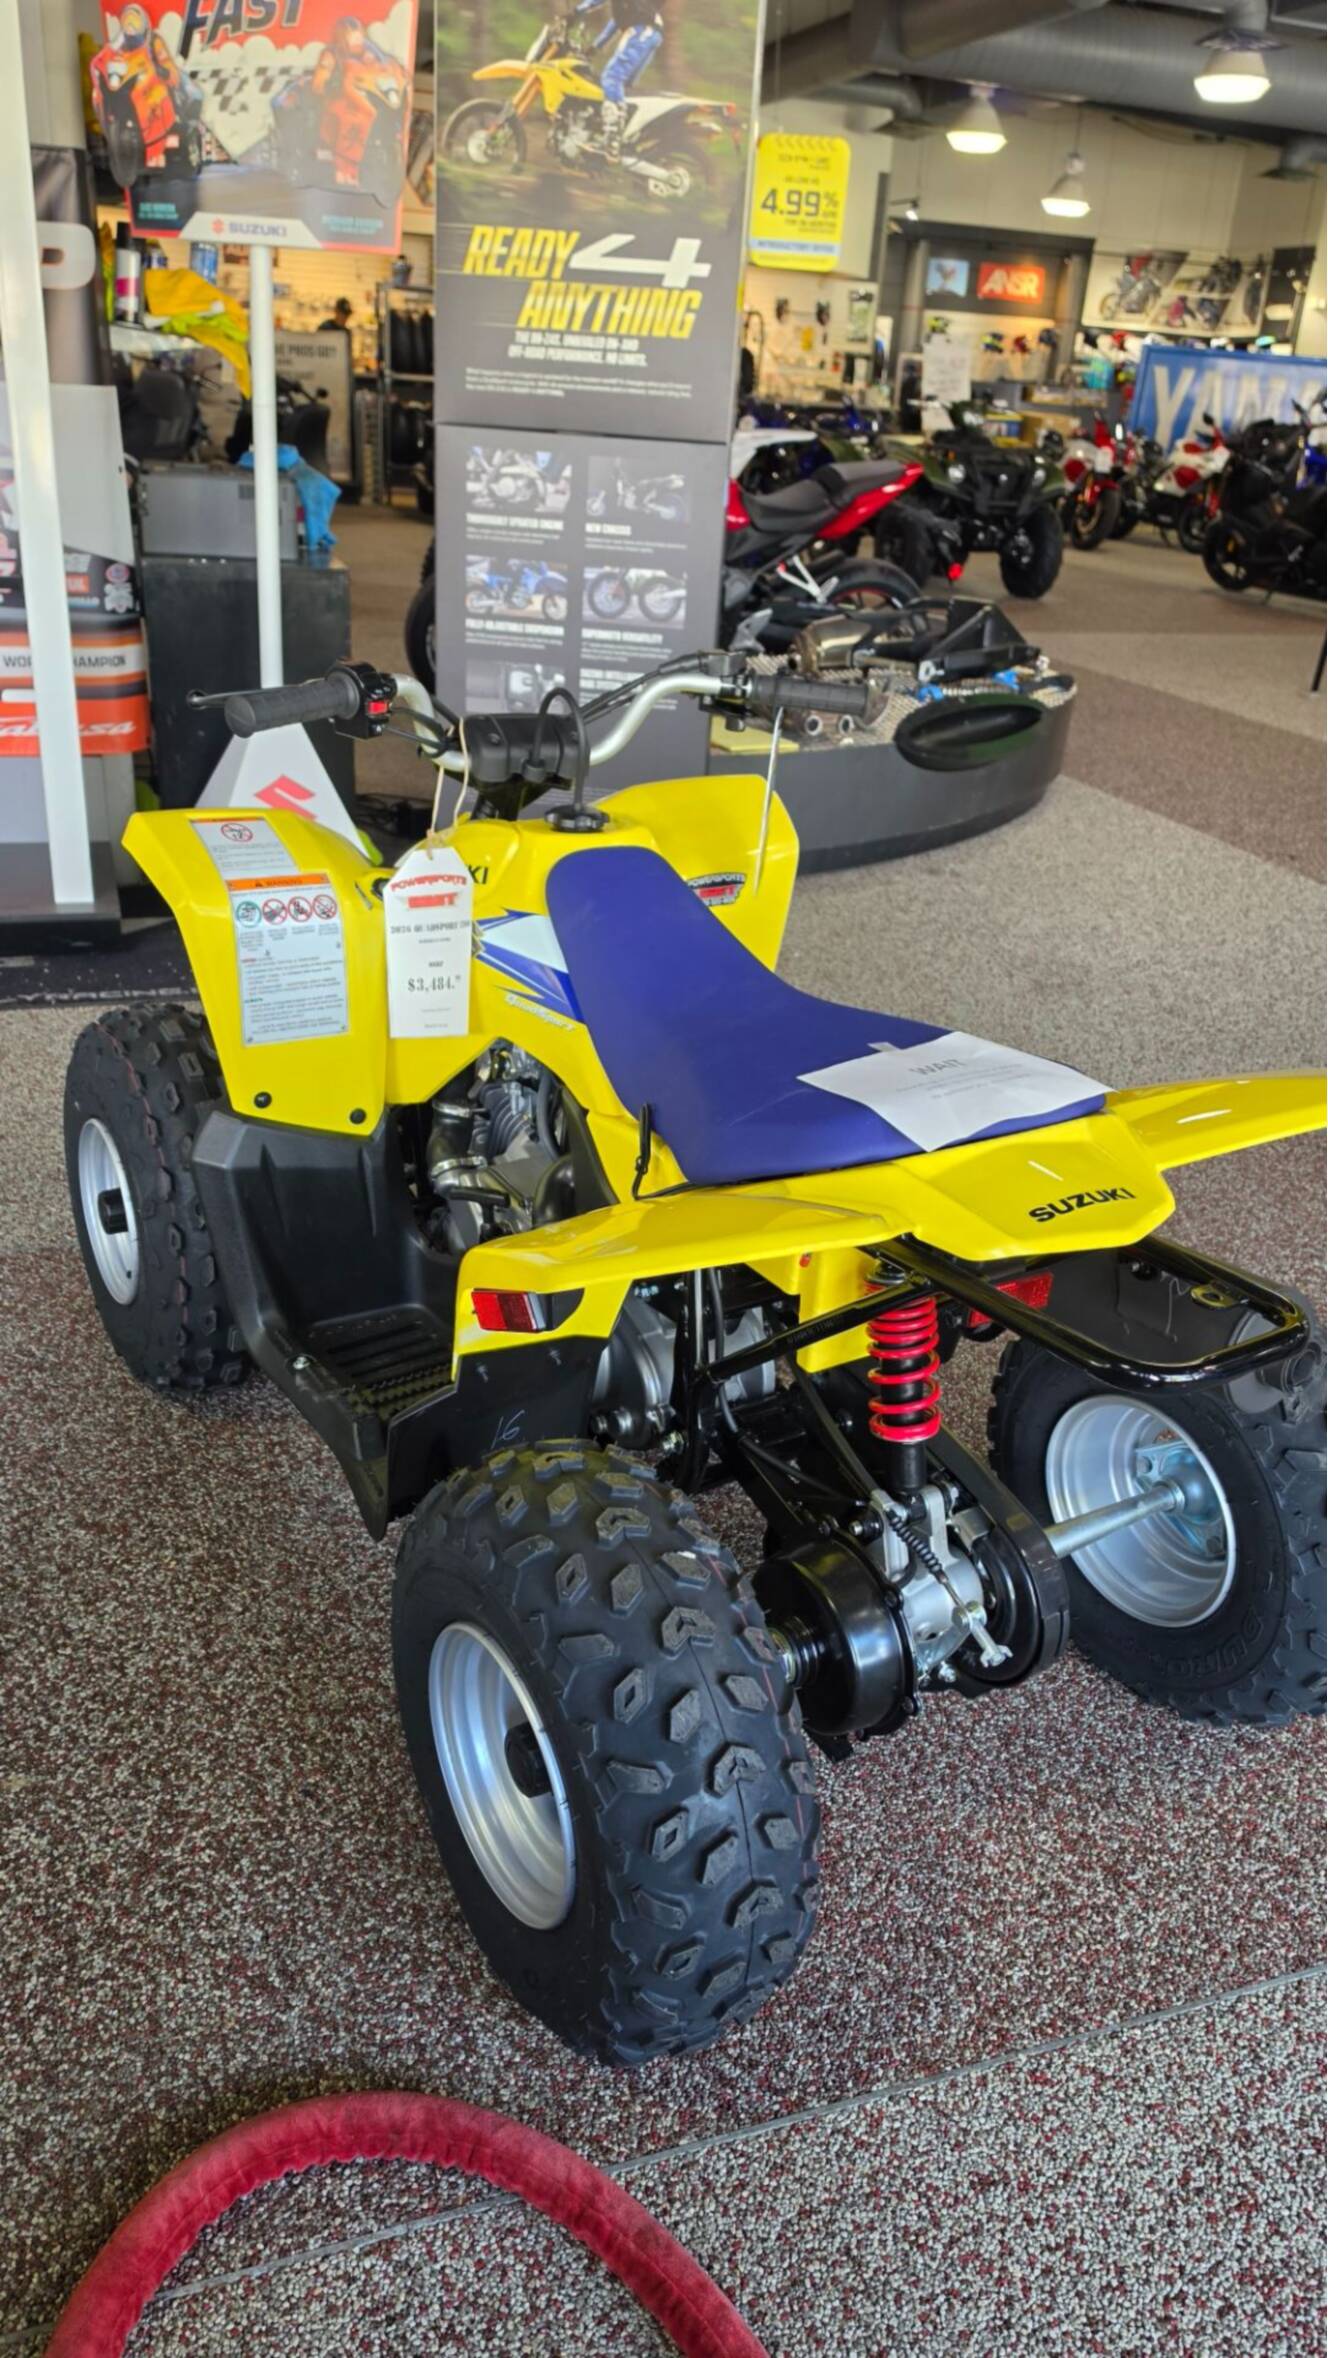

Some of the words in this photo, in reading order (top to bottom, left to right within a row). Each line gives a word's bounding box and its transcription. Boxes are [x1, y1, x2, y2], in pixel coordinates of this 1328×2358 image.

[228, 222, 288, 237] SUZUKI
[462, 225, 580, 279] READY
[568, 232, 712, 288] 4
[516, 280, 703, 339] ANYTHING
[72, 654, 126, 668] HAMPION
[1028, 1187, 1137, 1224] SUZUKI
